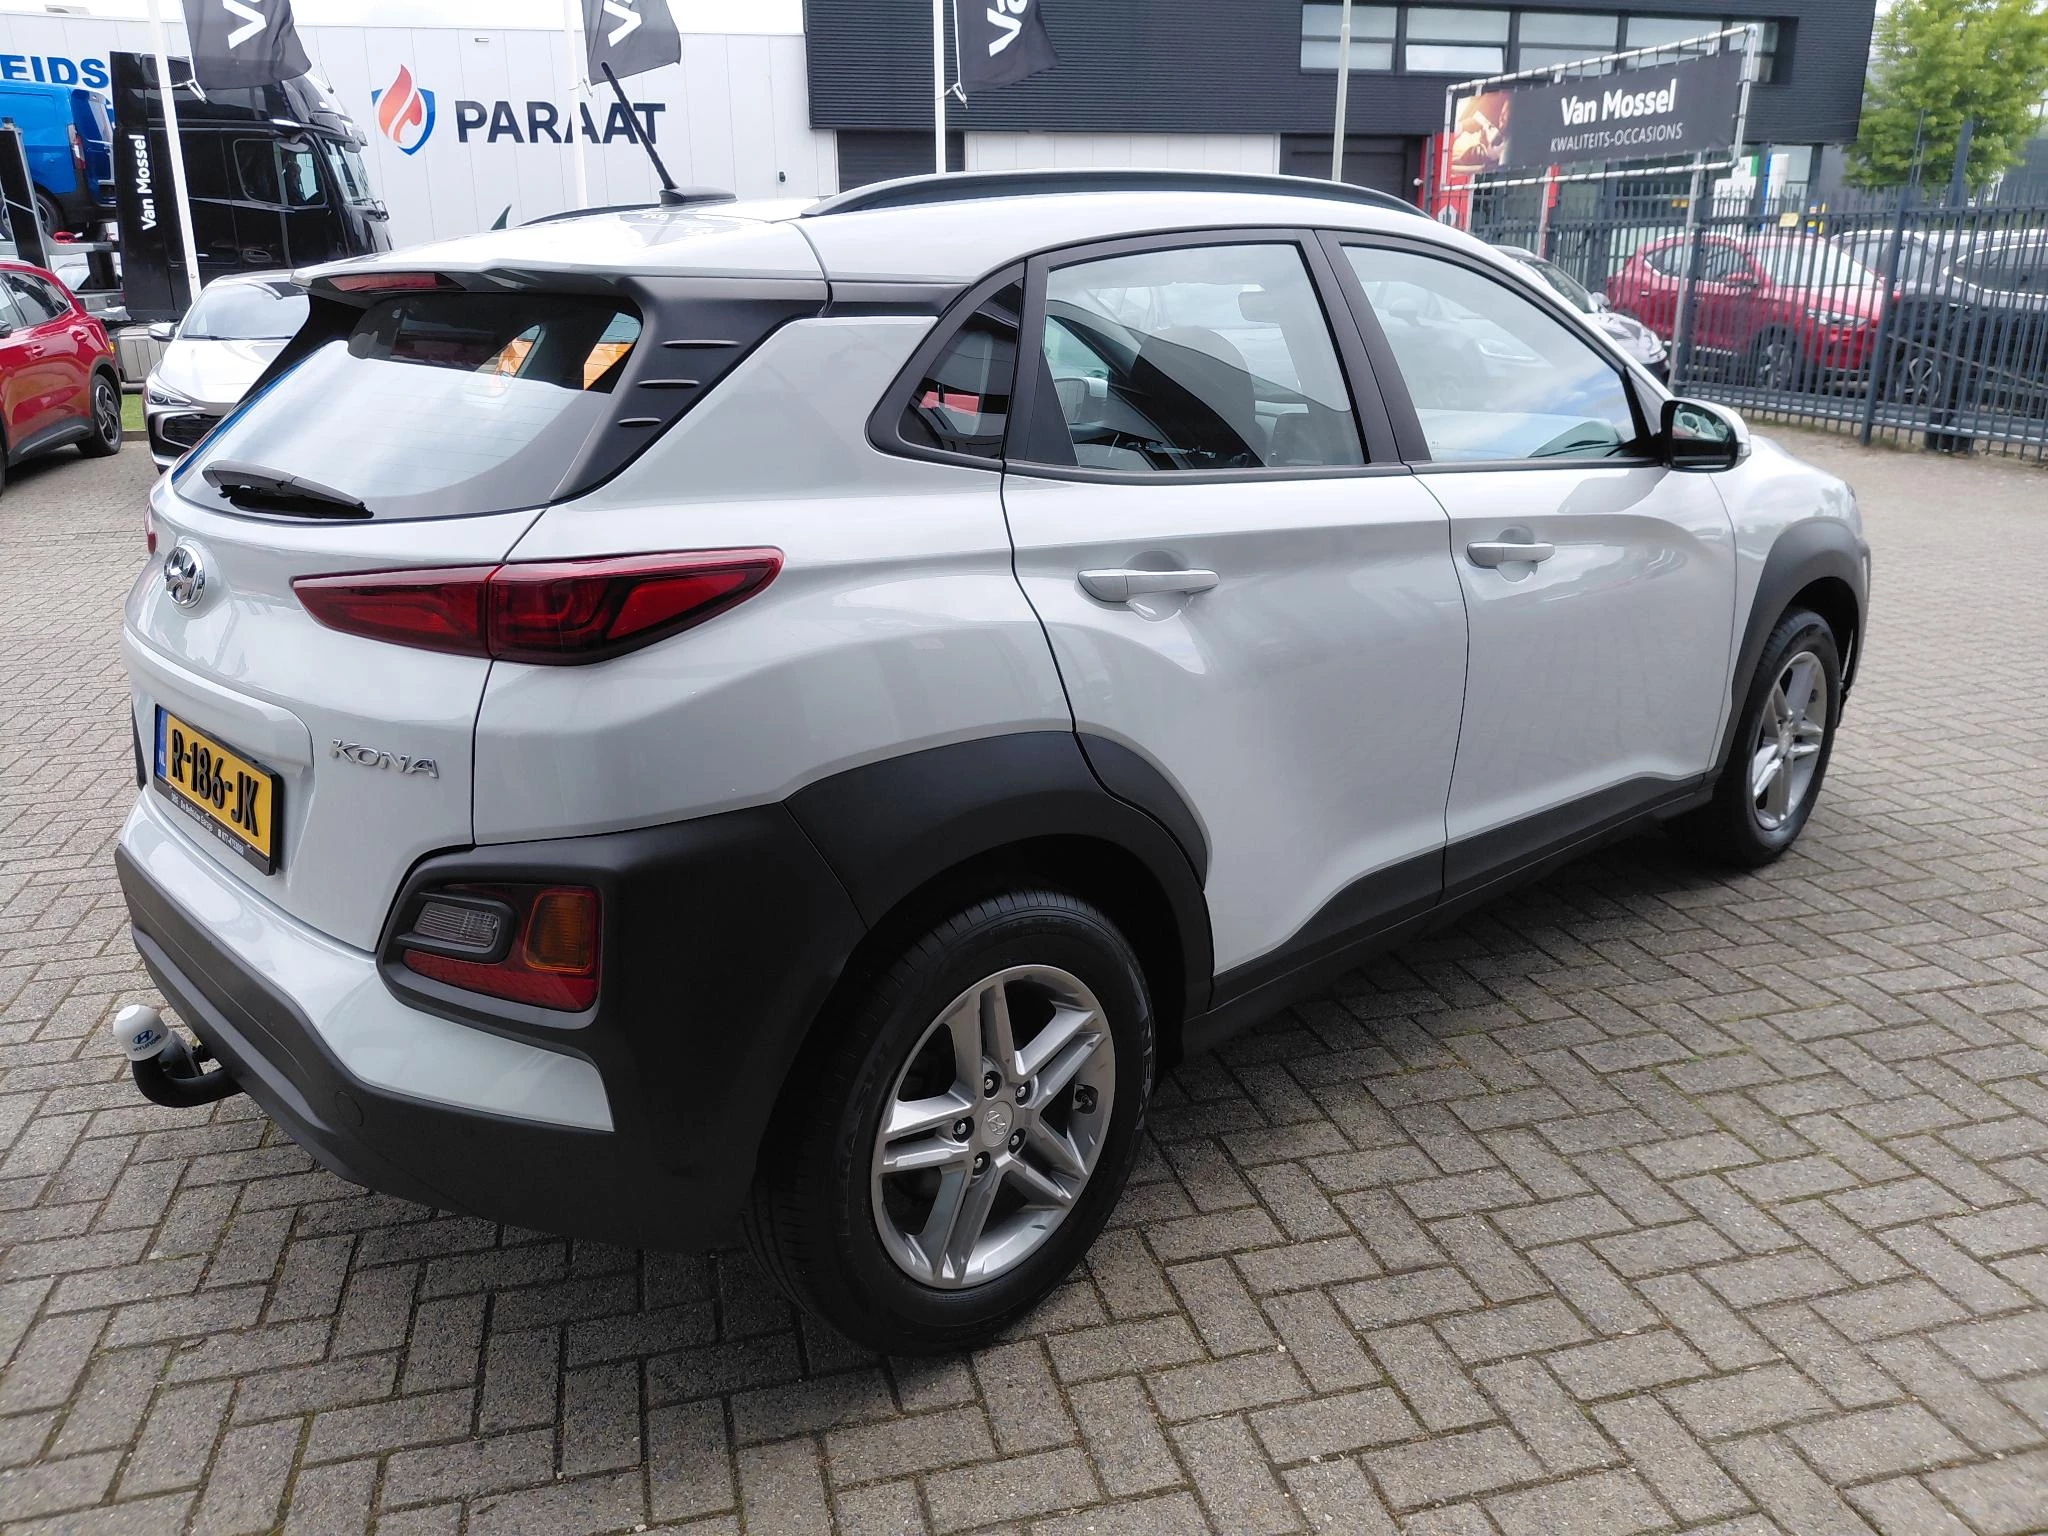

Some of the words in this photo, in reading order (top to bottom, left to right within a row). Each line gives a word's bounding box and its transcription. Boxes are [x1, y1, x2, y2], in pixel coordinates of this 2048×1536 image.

[222, 0, 267, 50] V
[603, 0, 642, 47] V
[455, 100, 666, 144] PARAAT
[1561, 95, 1597, 126] Van
[1601, 78, 1677, 121] Mossel
[1550, 122, 1683, 152] KWALITEITS-OCCASIONS
[128, 134, 153, 194] Mossel
[141, 198, 157, 231] Van
[330, 739, 439, 778] KONA
[172, 729, 259, 837] R-186-JK
